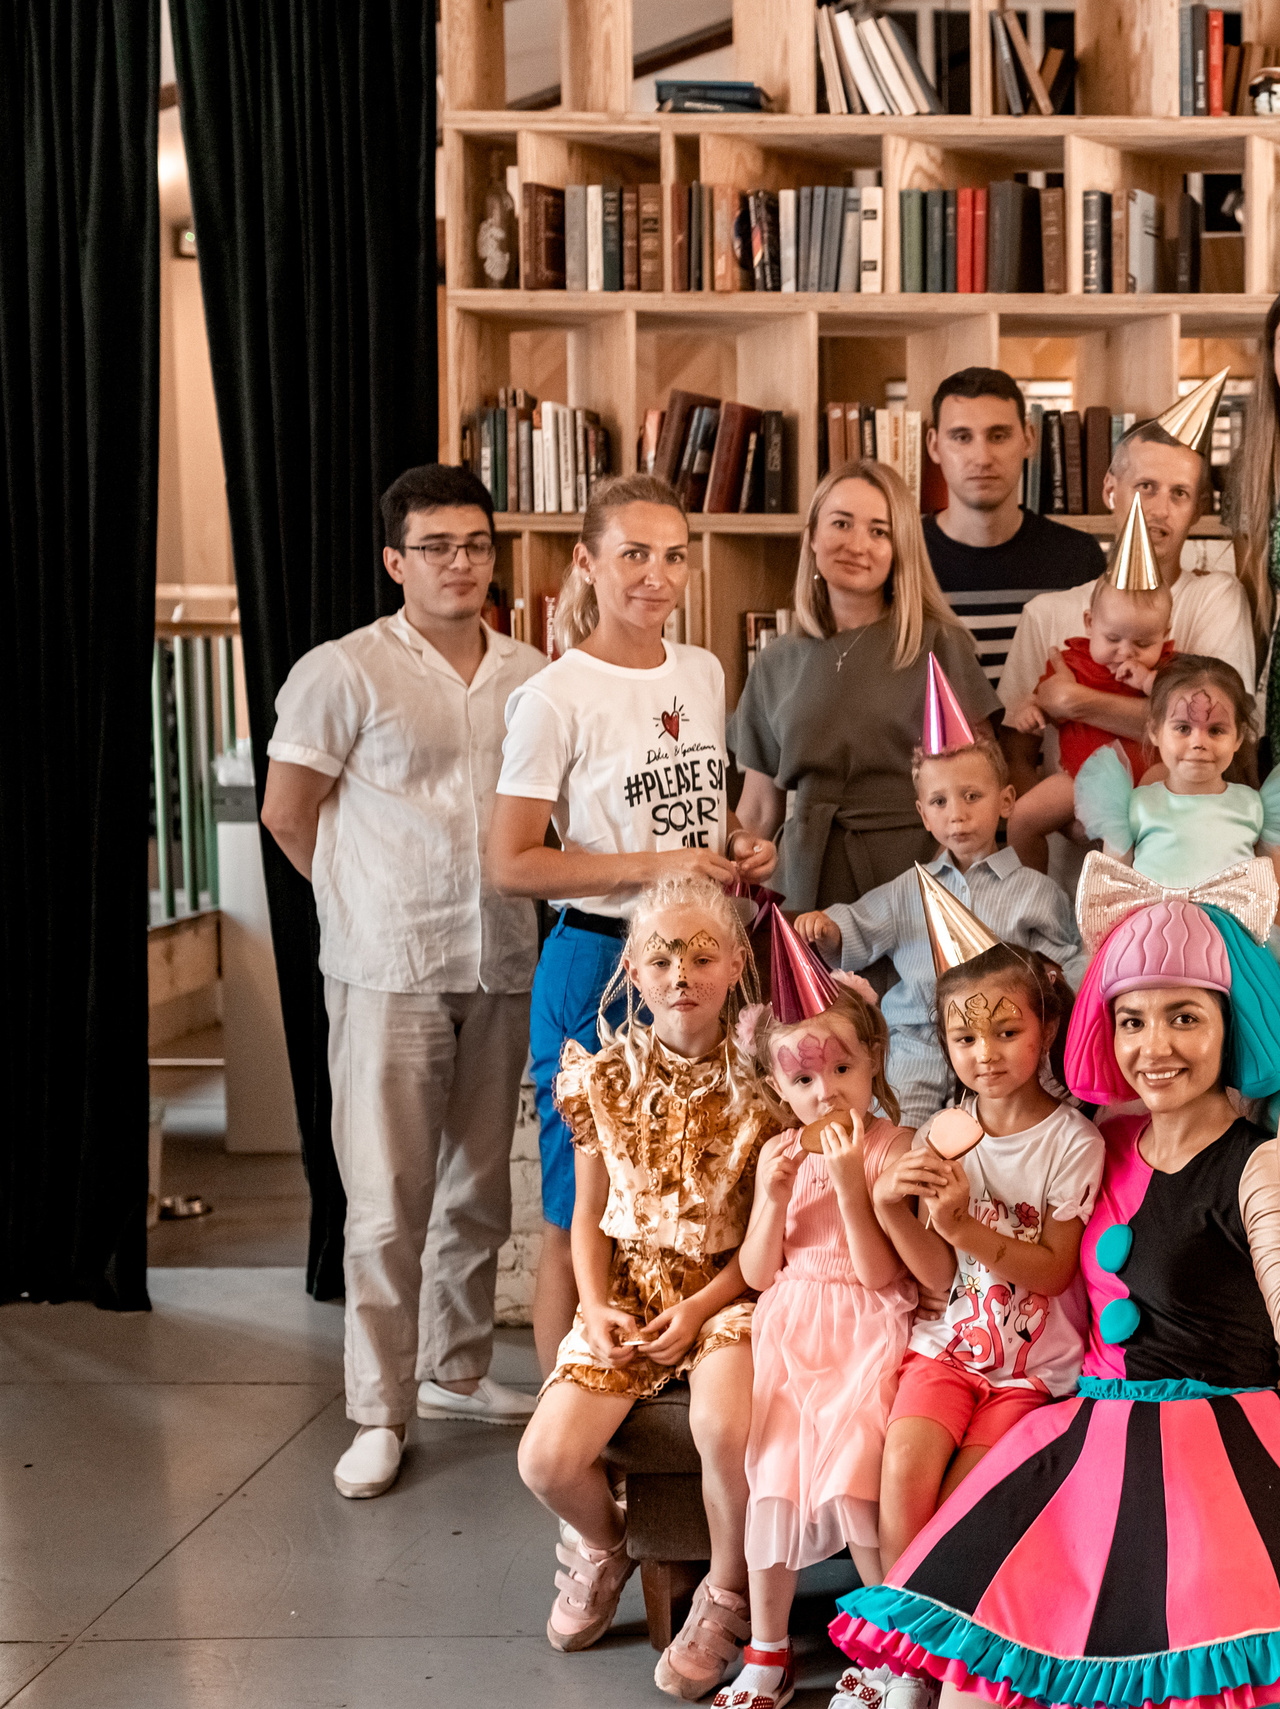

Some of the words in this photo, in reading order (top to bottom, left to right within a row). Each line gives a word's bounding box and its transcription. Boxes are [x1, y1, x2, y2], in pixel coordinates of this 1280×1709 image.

[624, 760, 702, 808] #PLEASE
[706, 758, 725, 791] SA
[651, 797, 720, 836] SORR
